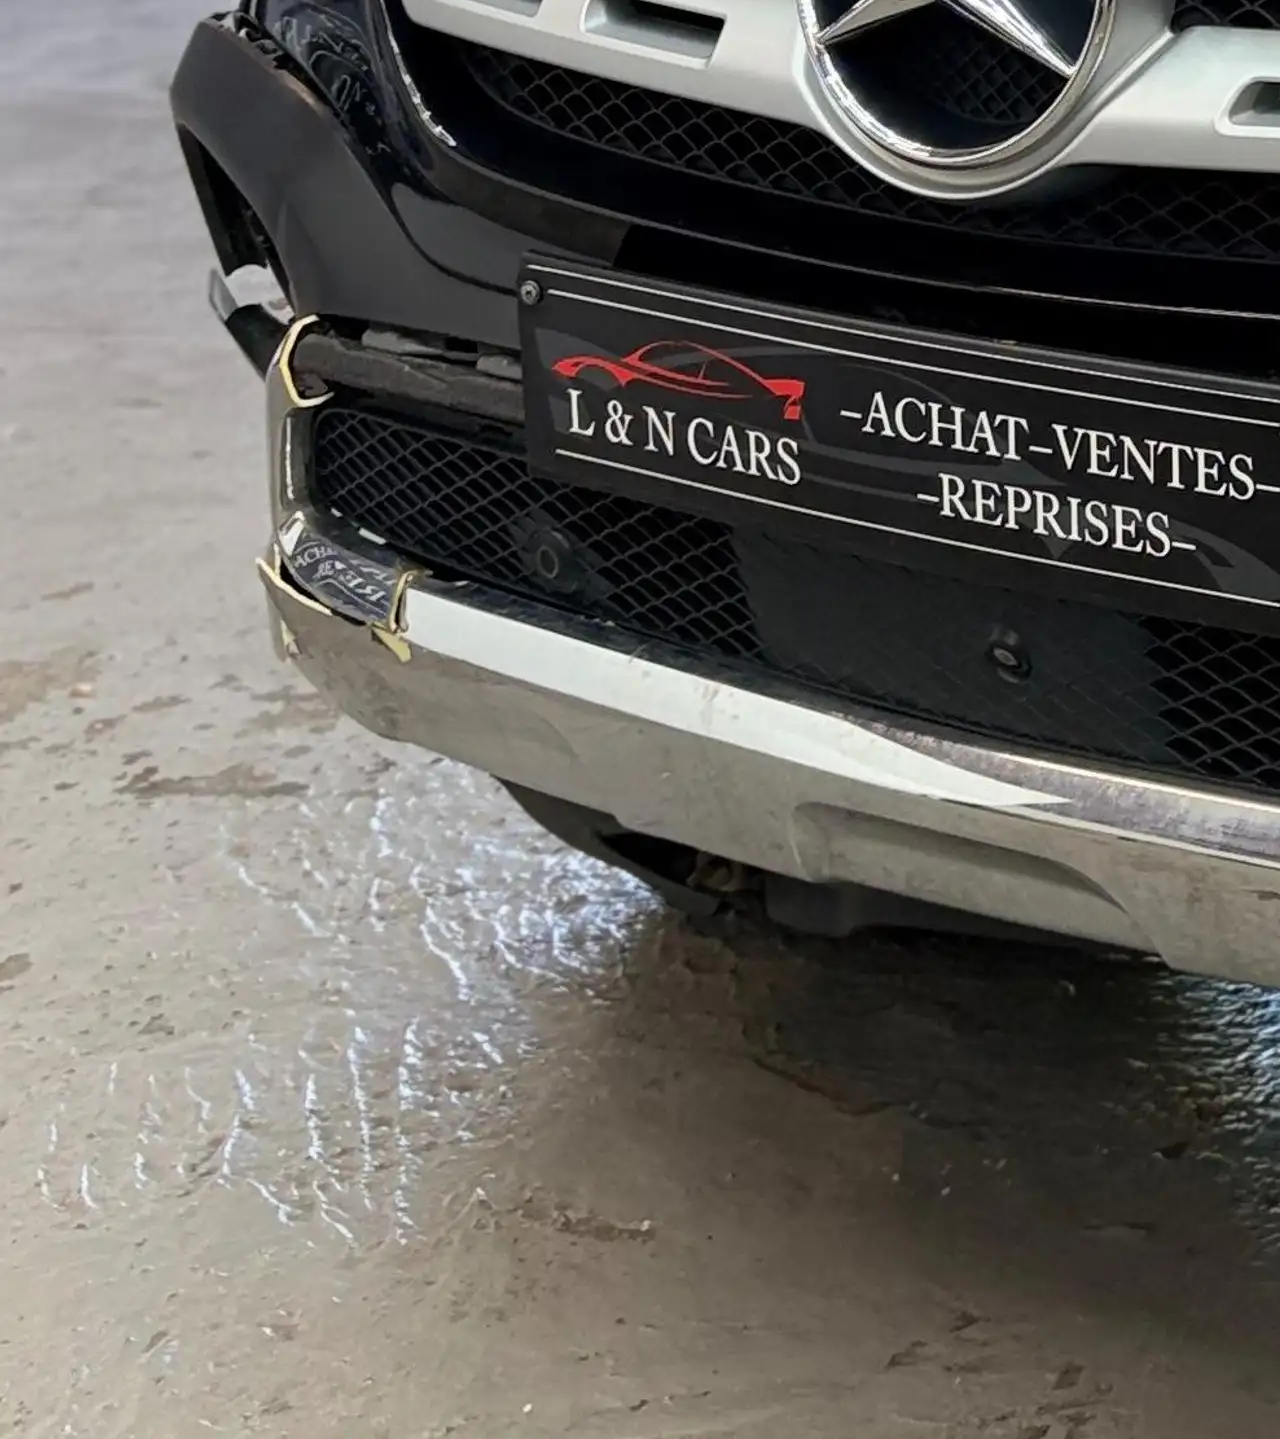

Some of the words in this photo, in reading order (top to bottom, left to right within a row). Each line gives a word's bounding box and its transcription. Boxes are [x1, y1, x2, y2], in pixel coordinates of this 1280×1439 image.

[568, 389, 596, 435] L
[606, 400, 633, 445] &
[643, 406, 676, 456] N
[688, 418, 801, 485] CARS
